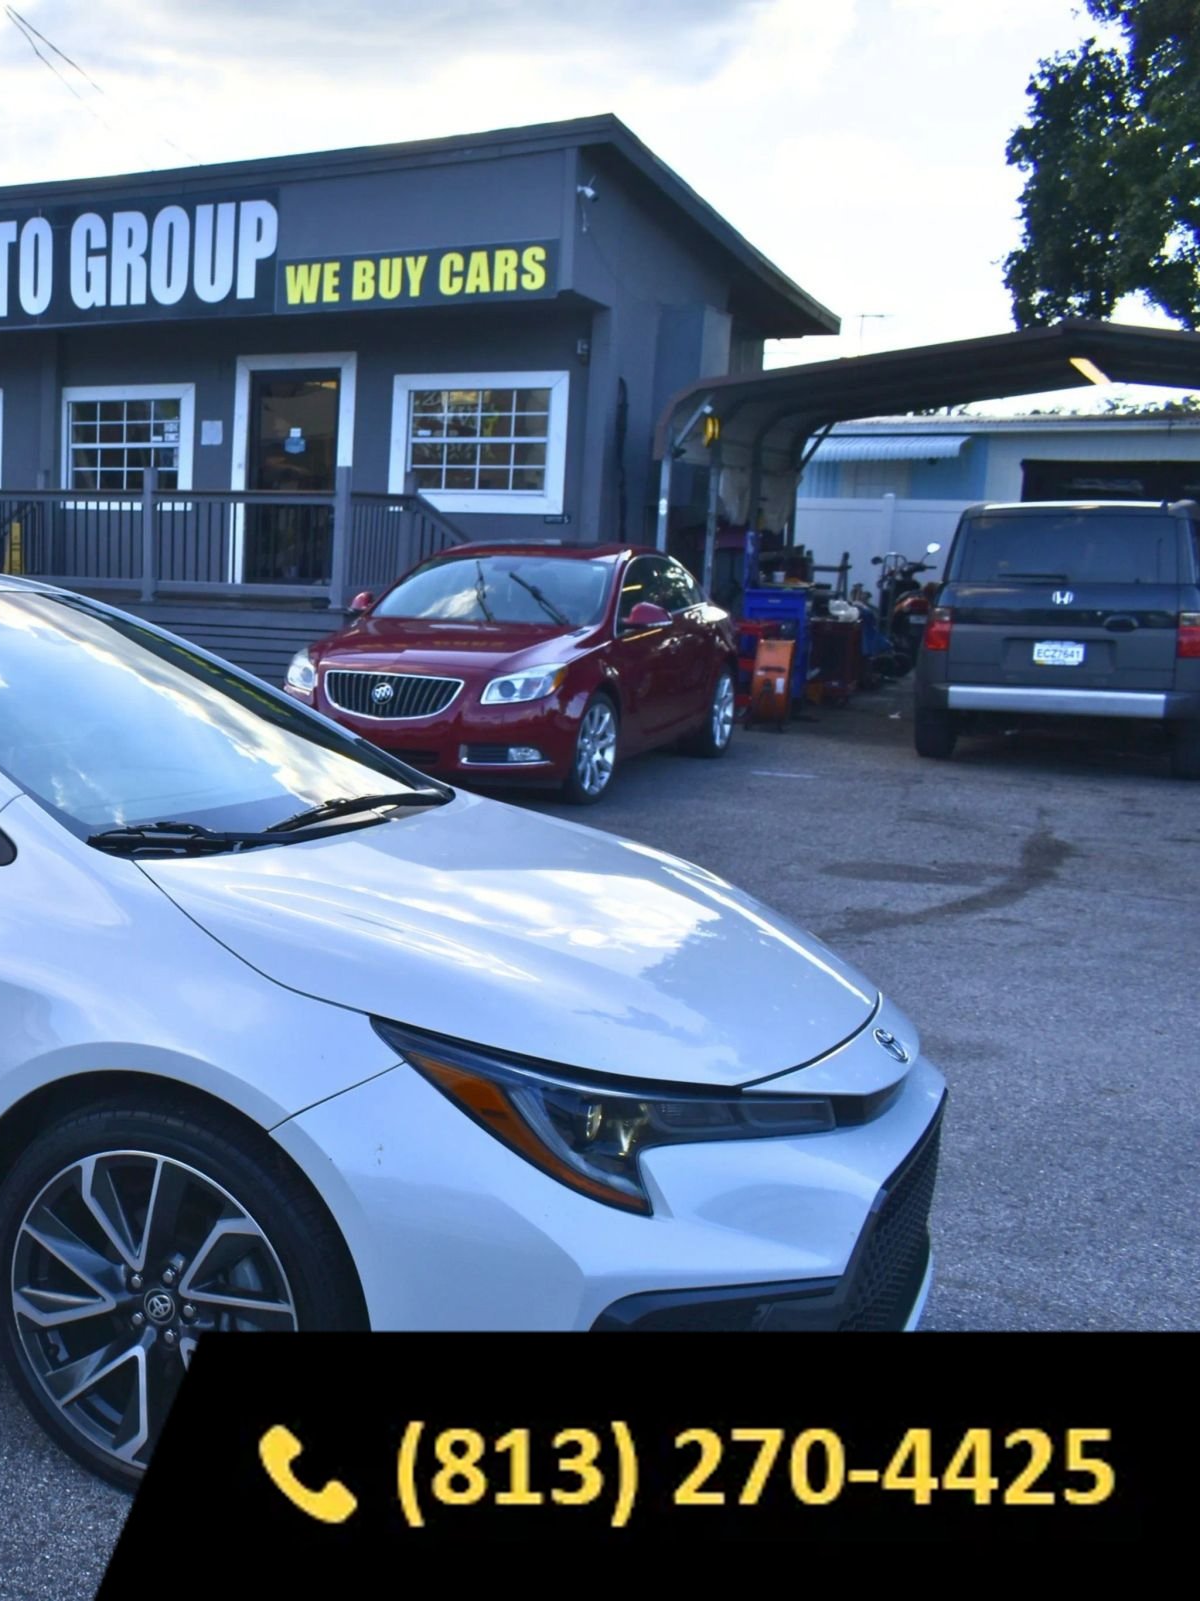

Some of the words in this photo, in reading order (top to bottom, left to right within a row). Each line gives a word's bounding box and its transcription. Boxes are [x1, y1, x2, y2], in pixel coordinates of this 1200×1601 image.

[70, 201, 278, 310] GROUP
[285, 262, 341, 304] WE
[351, 256, 428, 301] BUY
[439, 246, 546, 296] CARS
